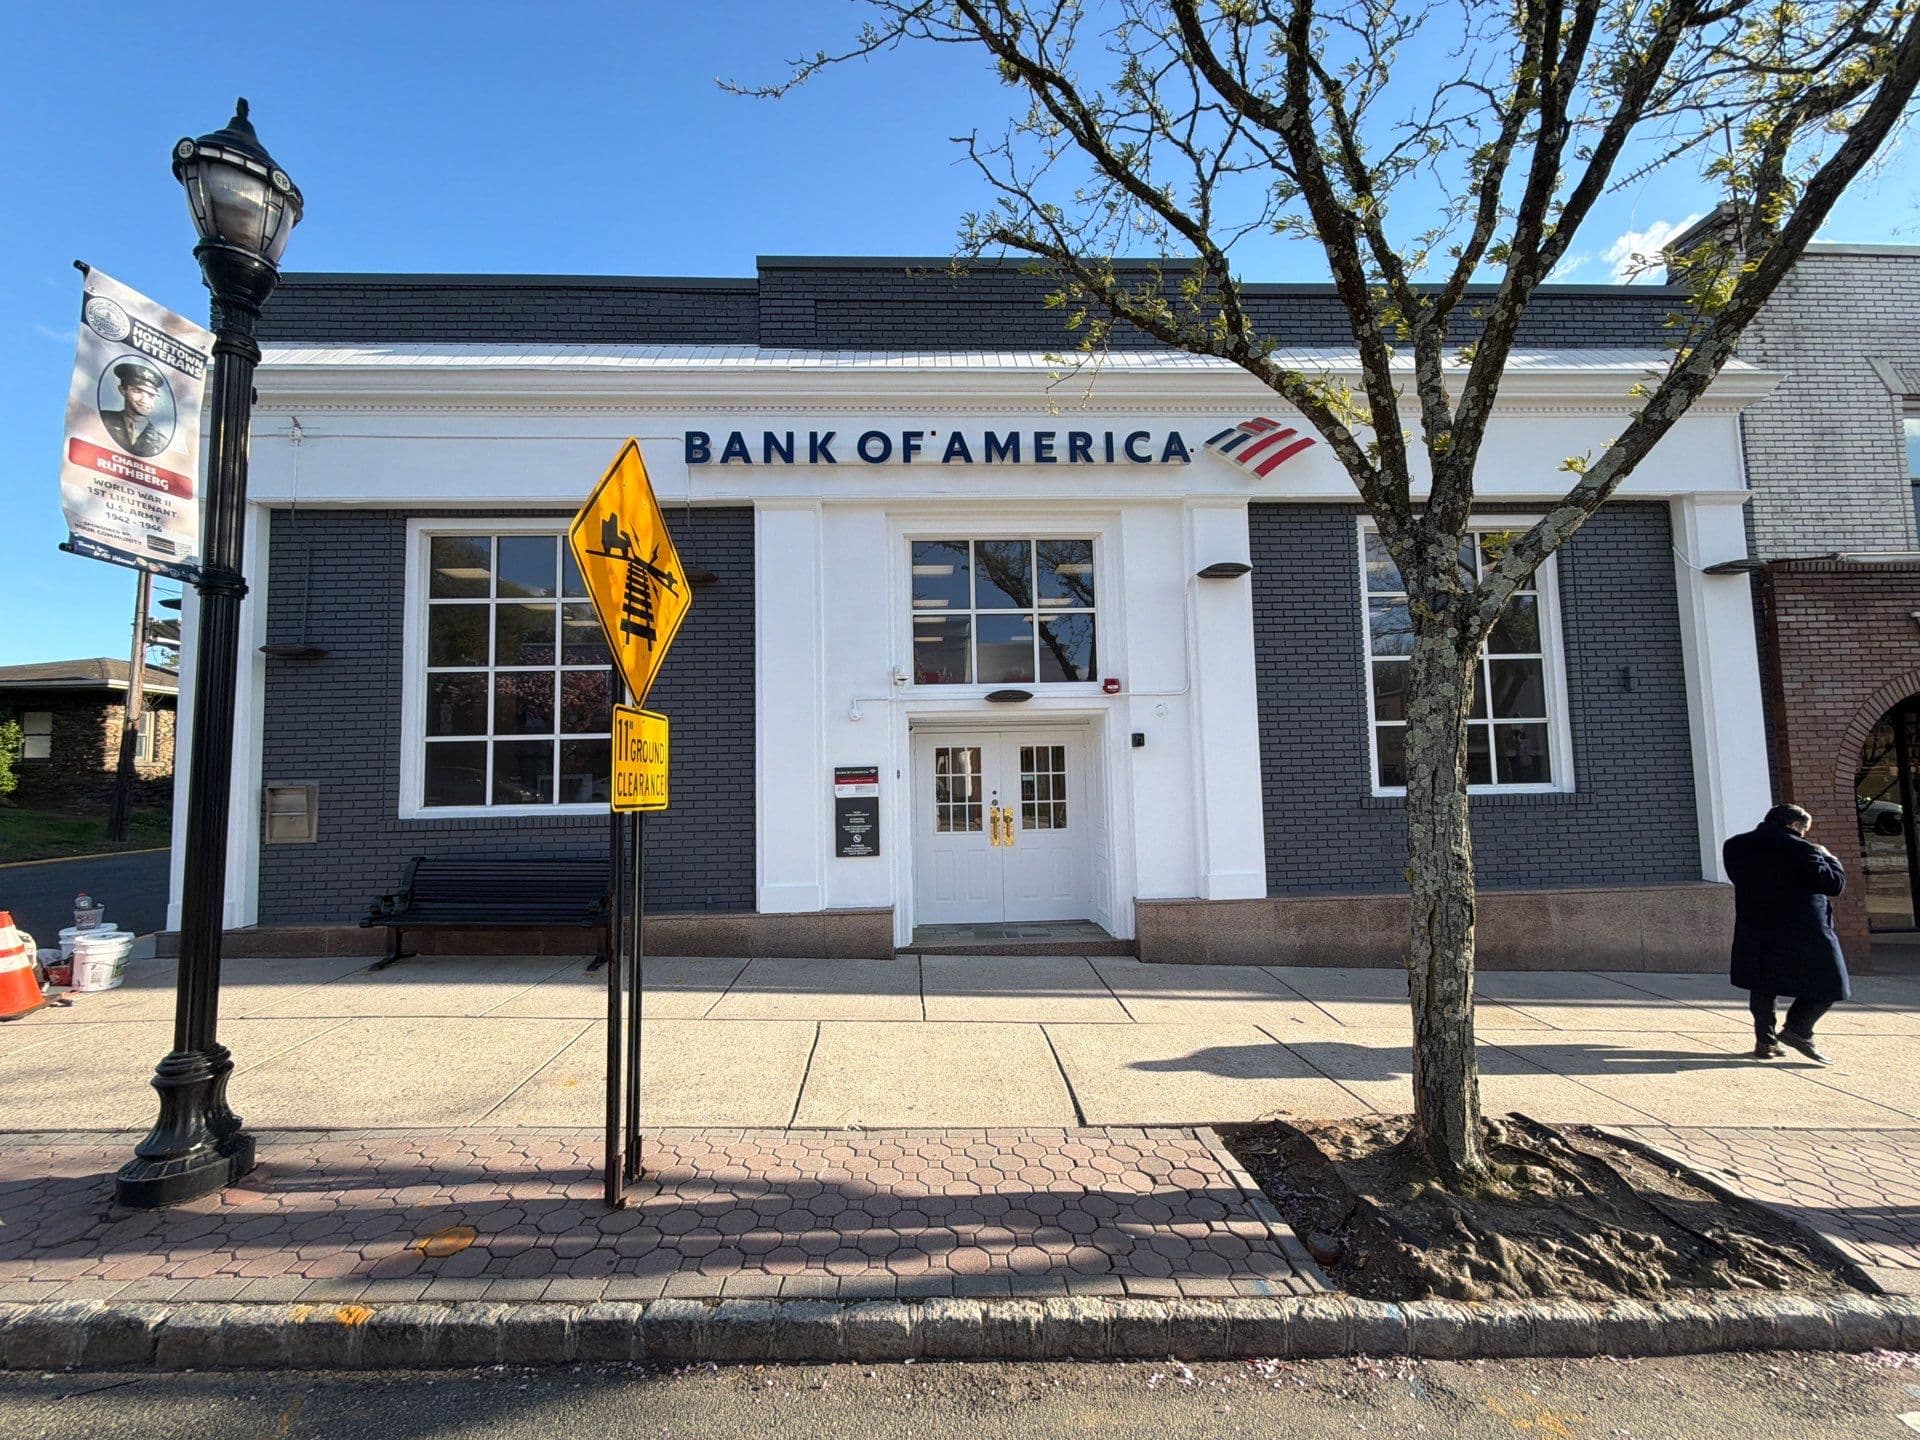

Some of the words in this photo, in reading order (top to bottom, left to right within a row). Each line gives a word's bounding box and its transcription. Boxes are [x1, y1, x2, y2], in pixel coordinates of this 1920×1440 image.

[180, 143, 193, 155] GR
[132, 335, 202, 378] VETERANS
[133, 326, 204, 369] HOMETOWN
[685, 431, 838, 464] BANK
[856, 430, 925, 464] OF
[941, 430, 1192, 463] AMERICA
[96, 457, 169, 490] RUTHBERG
[111, 454, 157, 475] CHARLES
[87, 486, 107, 498] 1ST
[110, 492, 177, 518] LIEUTENANT
[93, 477, 135, 495] WORLD
[137, 491, 162, 505] WAR
[105, 501, 128, 514] U.S.
[129, 508, 163, 523] ARMY
[105, 512, 131, 525] 1942
[74, 523, 96, 533] YOUR
[96, 529, 143, 546] COMMUNITY
[618, 718, 634, 761] 11"
[630, 738, 665, 764] GROUND
[617, 772, 665, 797] CLEARANCE
